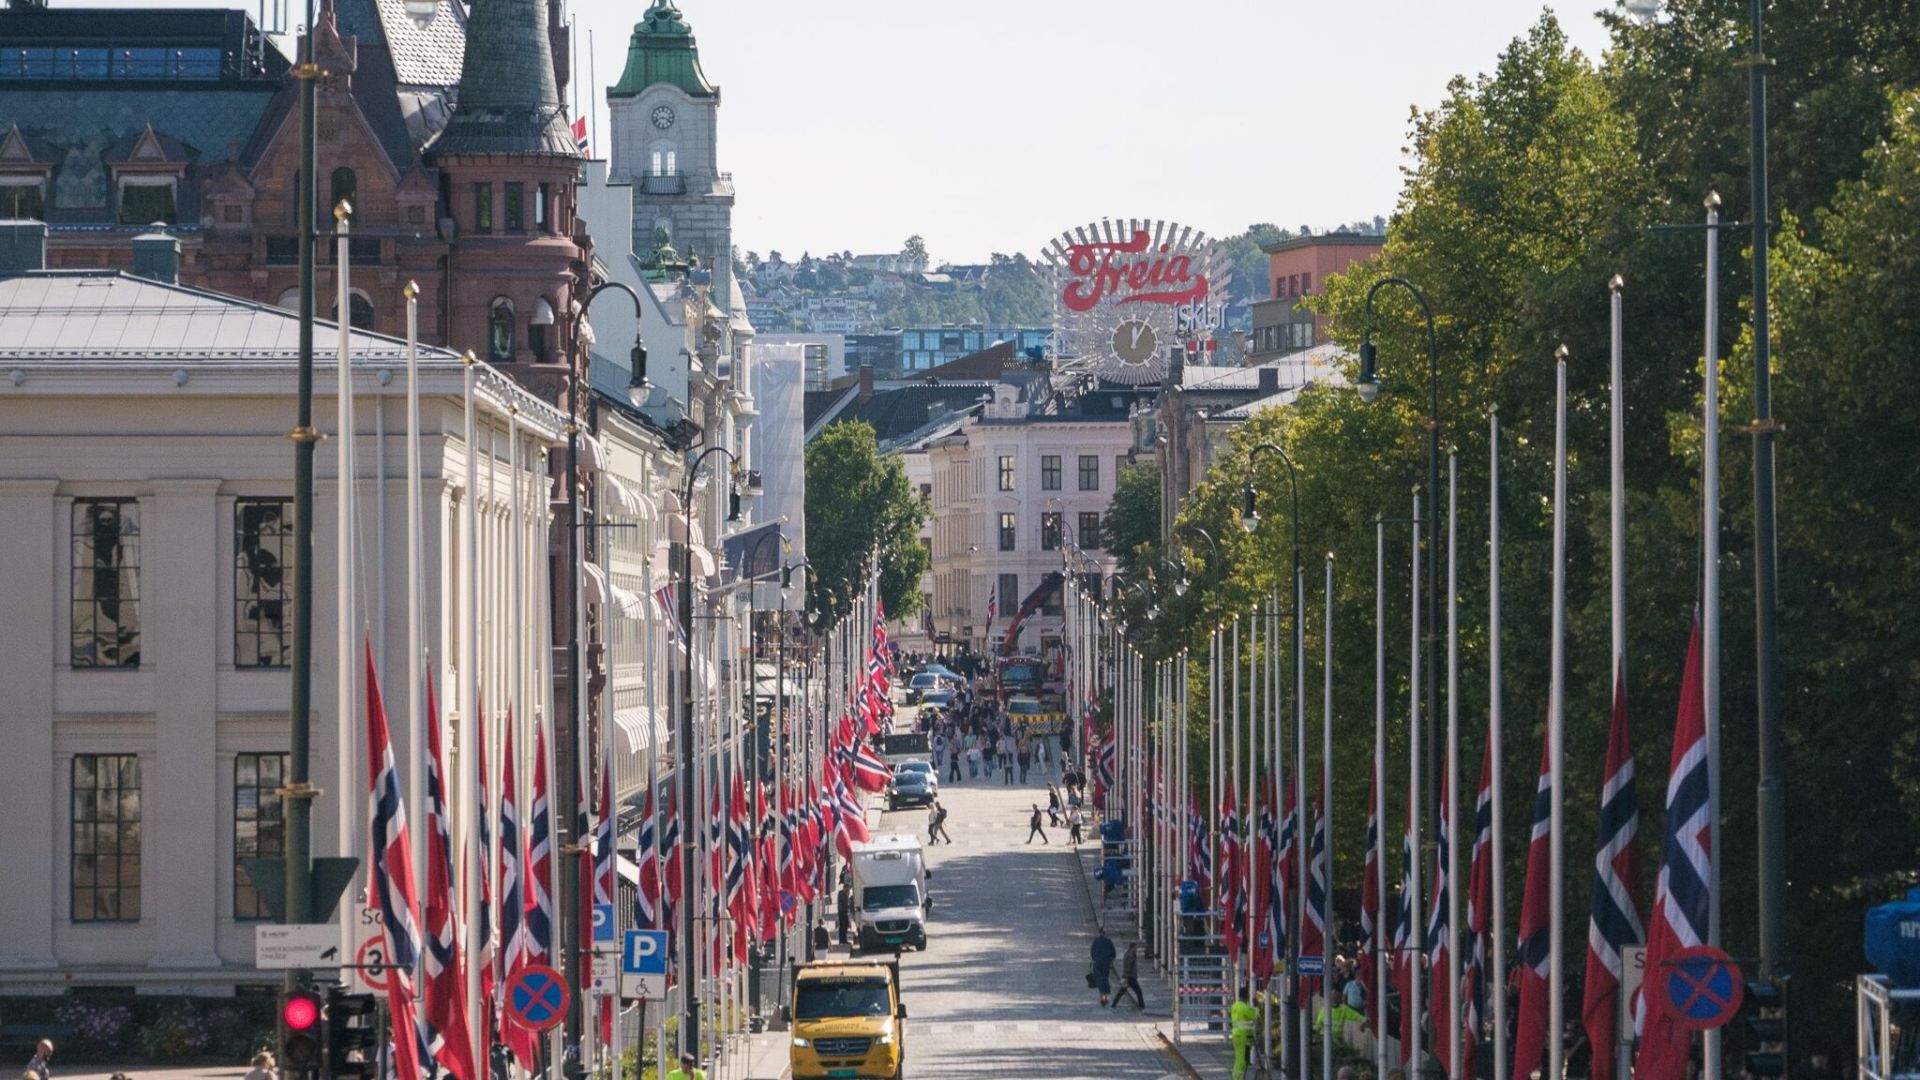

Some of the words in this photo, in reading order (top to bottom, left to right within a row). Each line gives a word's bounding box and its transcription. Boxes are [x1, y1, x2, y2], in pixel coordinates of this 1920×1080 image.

[1063, 231, 1208, 312] Freia
[1174, 295, 1230, 331] isklar
[1901, 921, 1920, 938] nr
[633, 935, 657, 968] P
